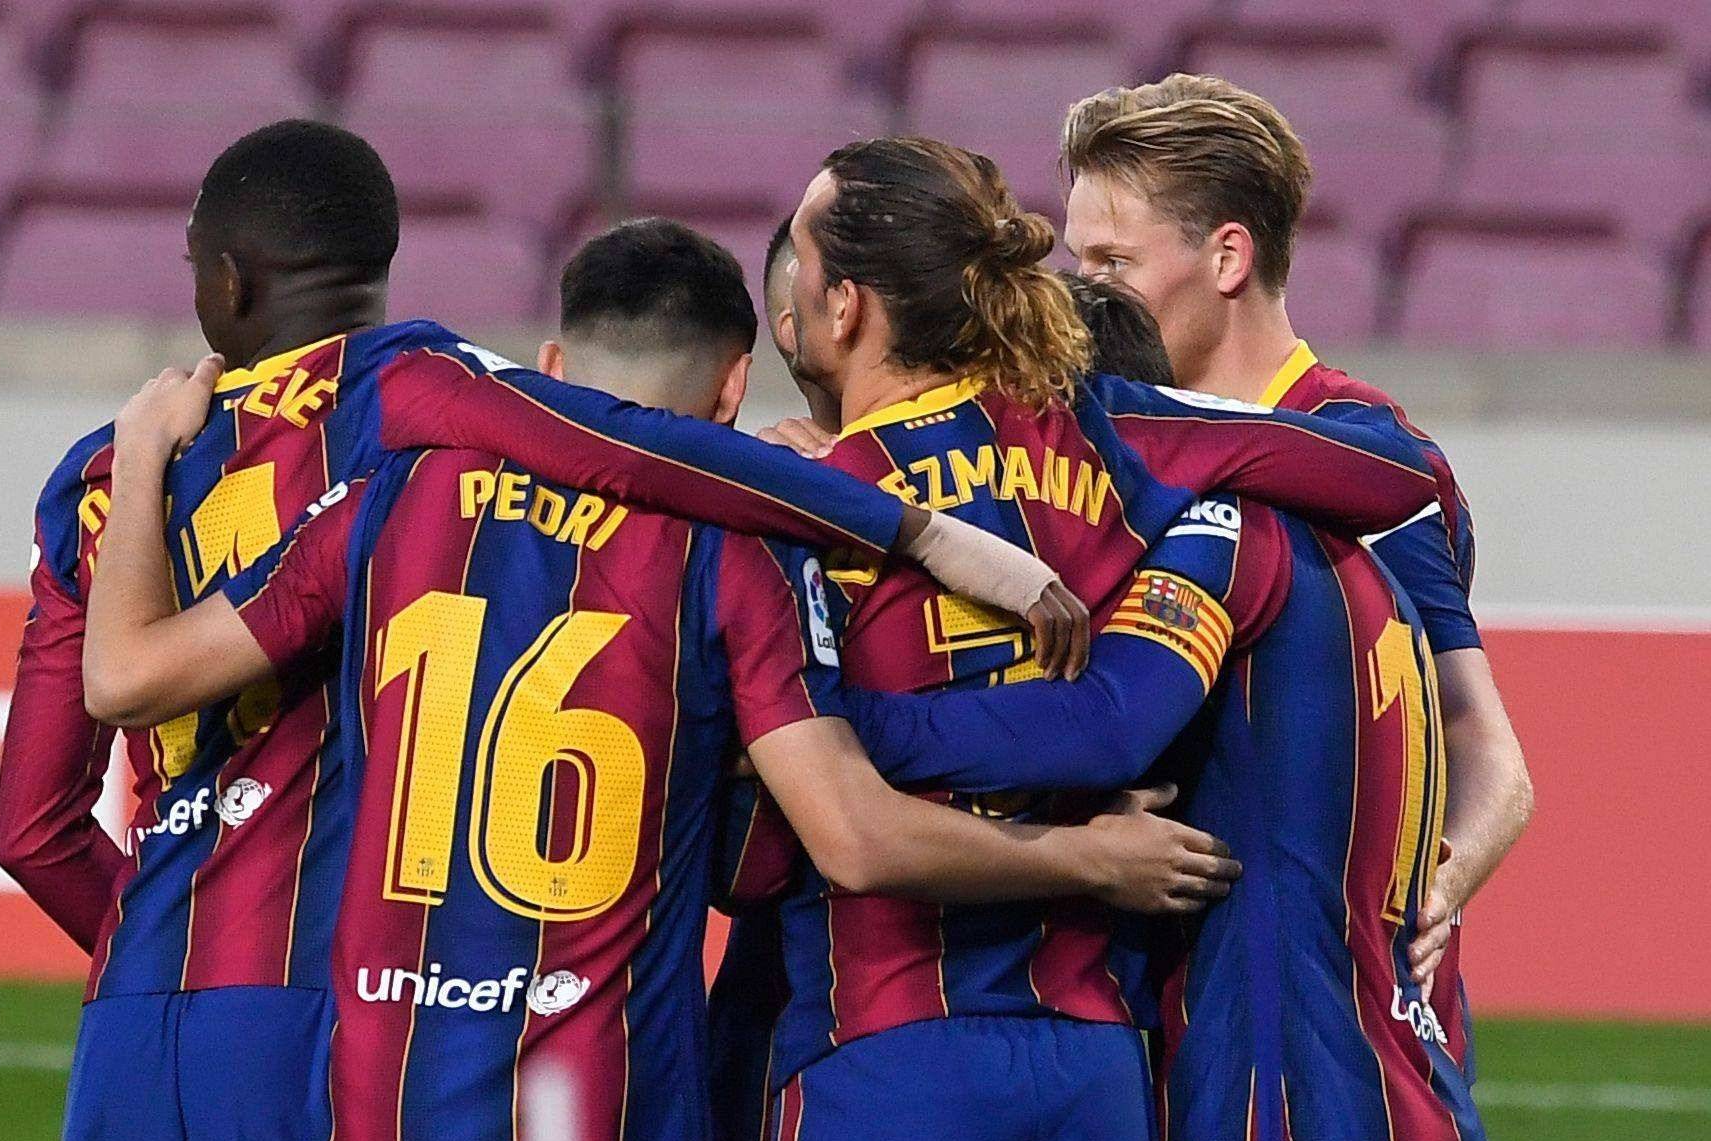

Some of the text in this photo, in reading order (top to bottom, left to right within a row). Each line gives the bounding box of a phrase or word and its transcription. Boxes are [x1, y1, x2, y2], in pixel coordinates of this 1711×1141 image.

[459, 470, 629, 551] PEDRI
[373, 590, 645, 922] 16
[356, 962, 528, 1013] unicef
